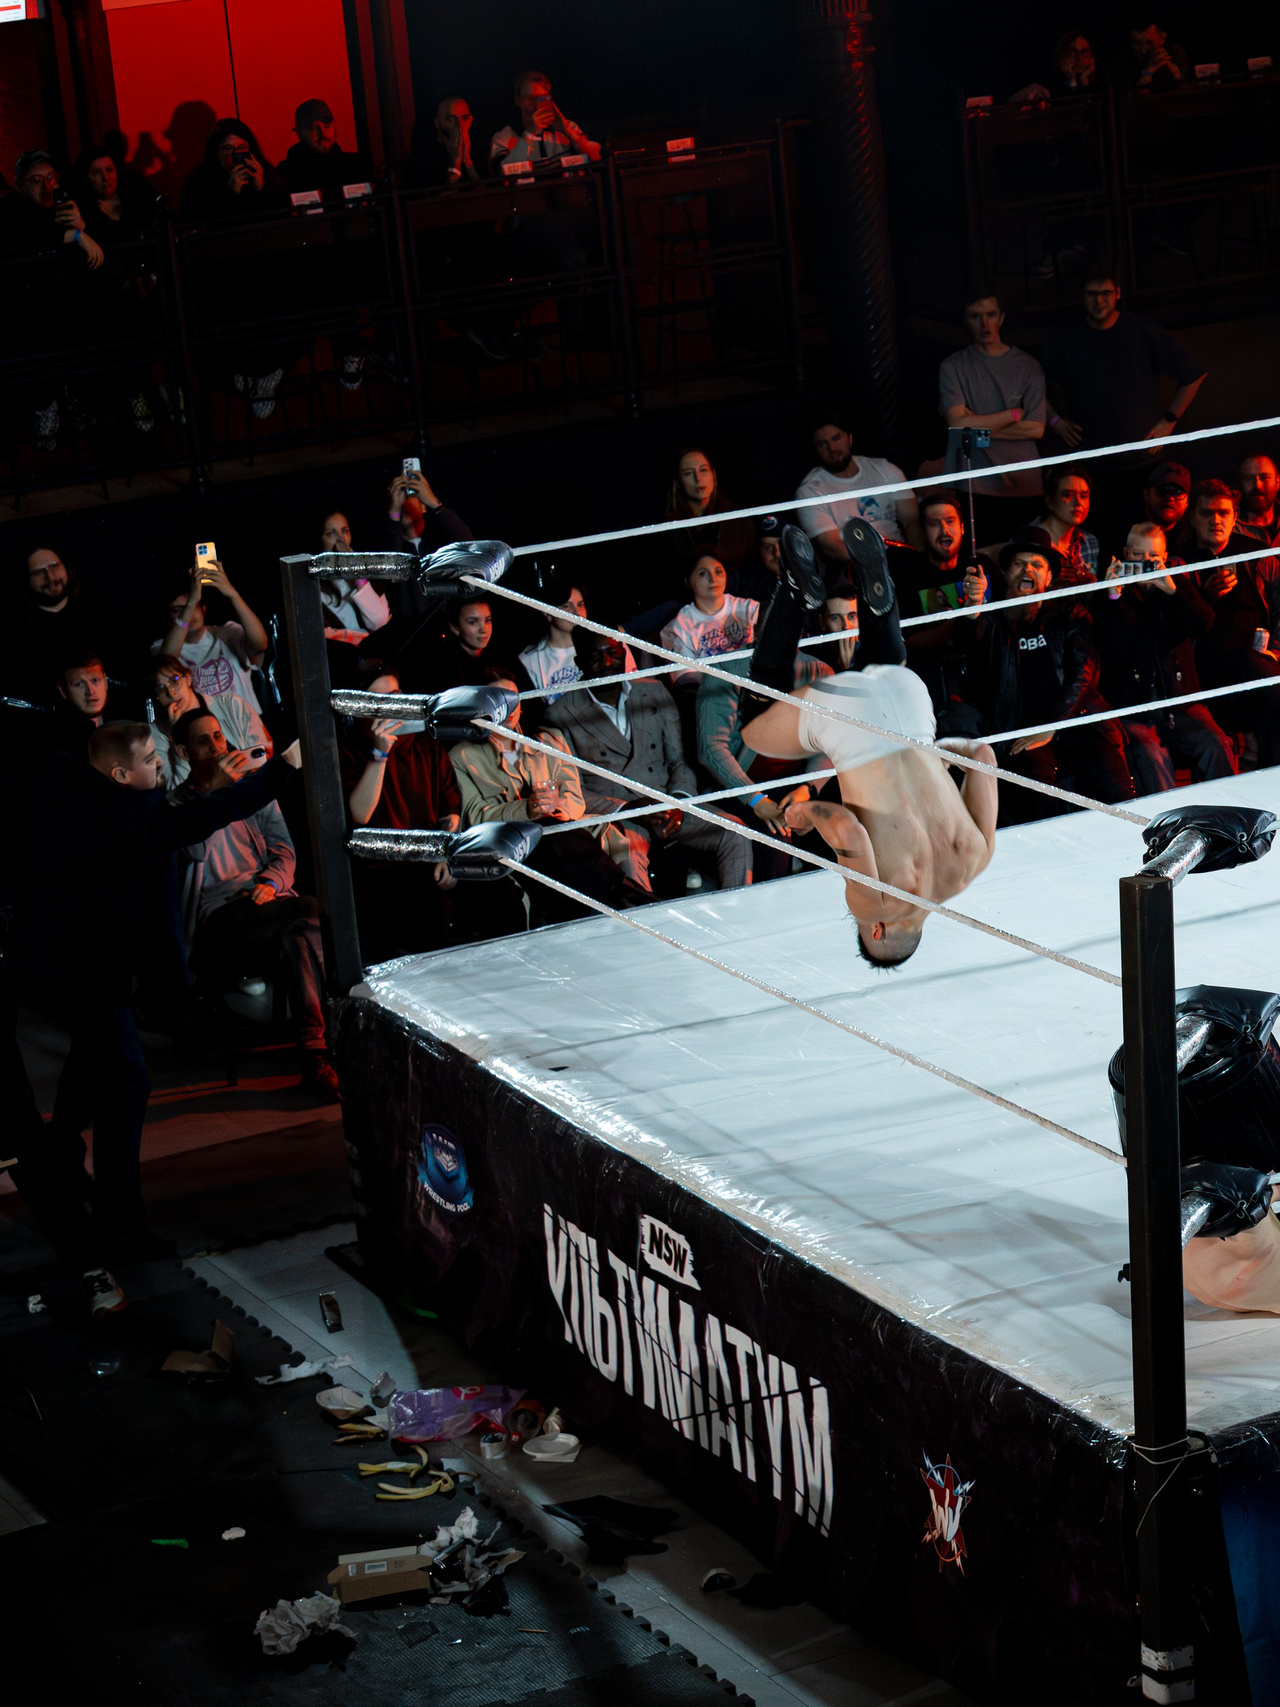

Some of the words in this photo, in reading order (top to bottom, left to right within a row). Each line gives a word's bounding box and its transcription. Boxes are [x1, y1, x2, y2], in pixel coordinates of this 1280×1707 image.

[424, 1181, 456, 1212] WRESTLING
[457, 1202, 471, 1212] POOL
[650, 1220, 688, 1279] NSW
